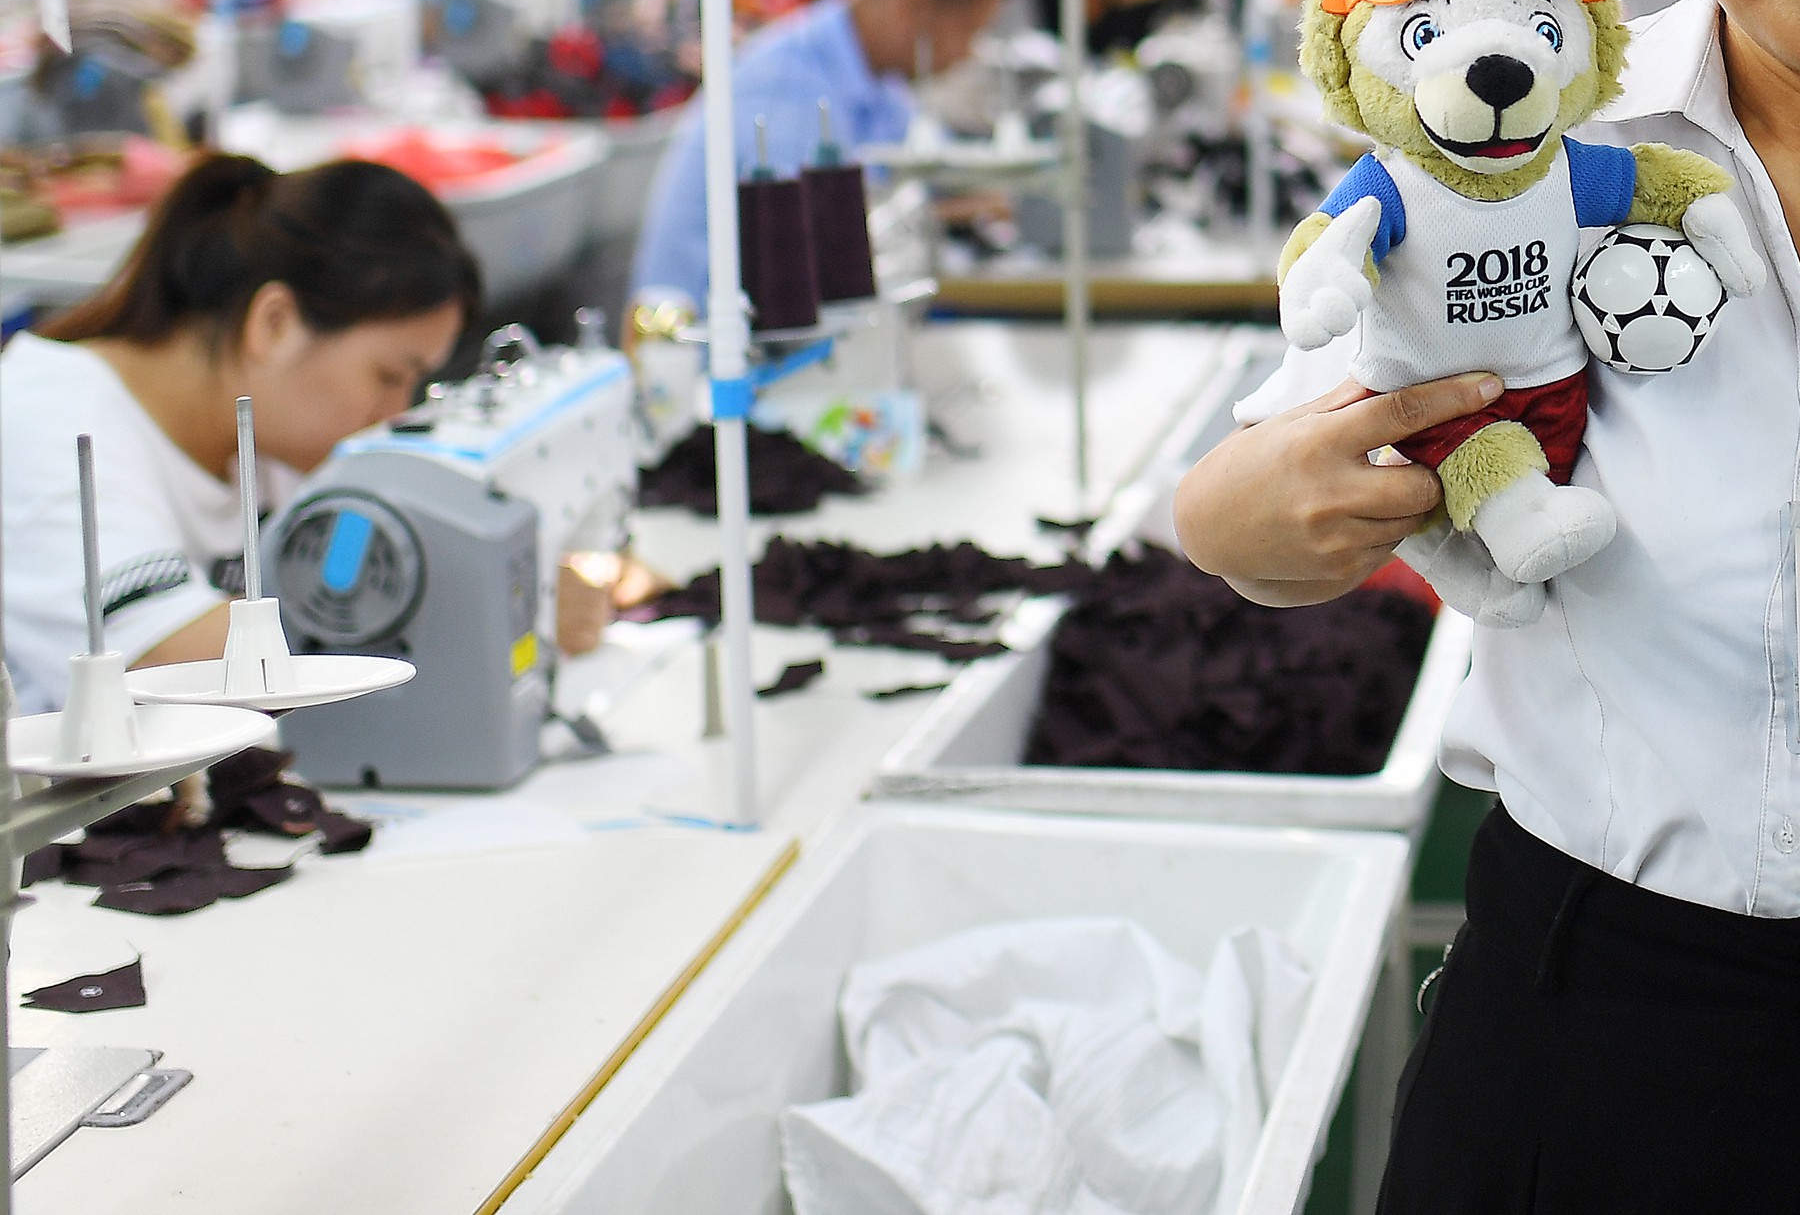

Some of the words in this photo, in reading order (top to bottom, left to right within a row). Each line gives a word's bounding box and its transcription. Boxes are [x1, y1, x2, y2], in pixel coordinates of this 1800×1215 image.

[1447, 240, 1548, 287] 2018
[1447, 290, 1475, 300] FIFA
[1478, 283, 1524, 299] WORLD
[1526, 275, 1549, 291] CUP
[1447, 290, 1549, 324] RUSSIA
